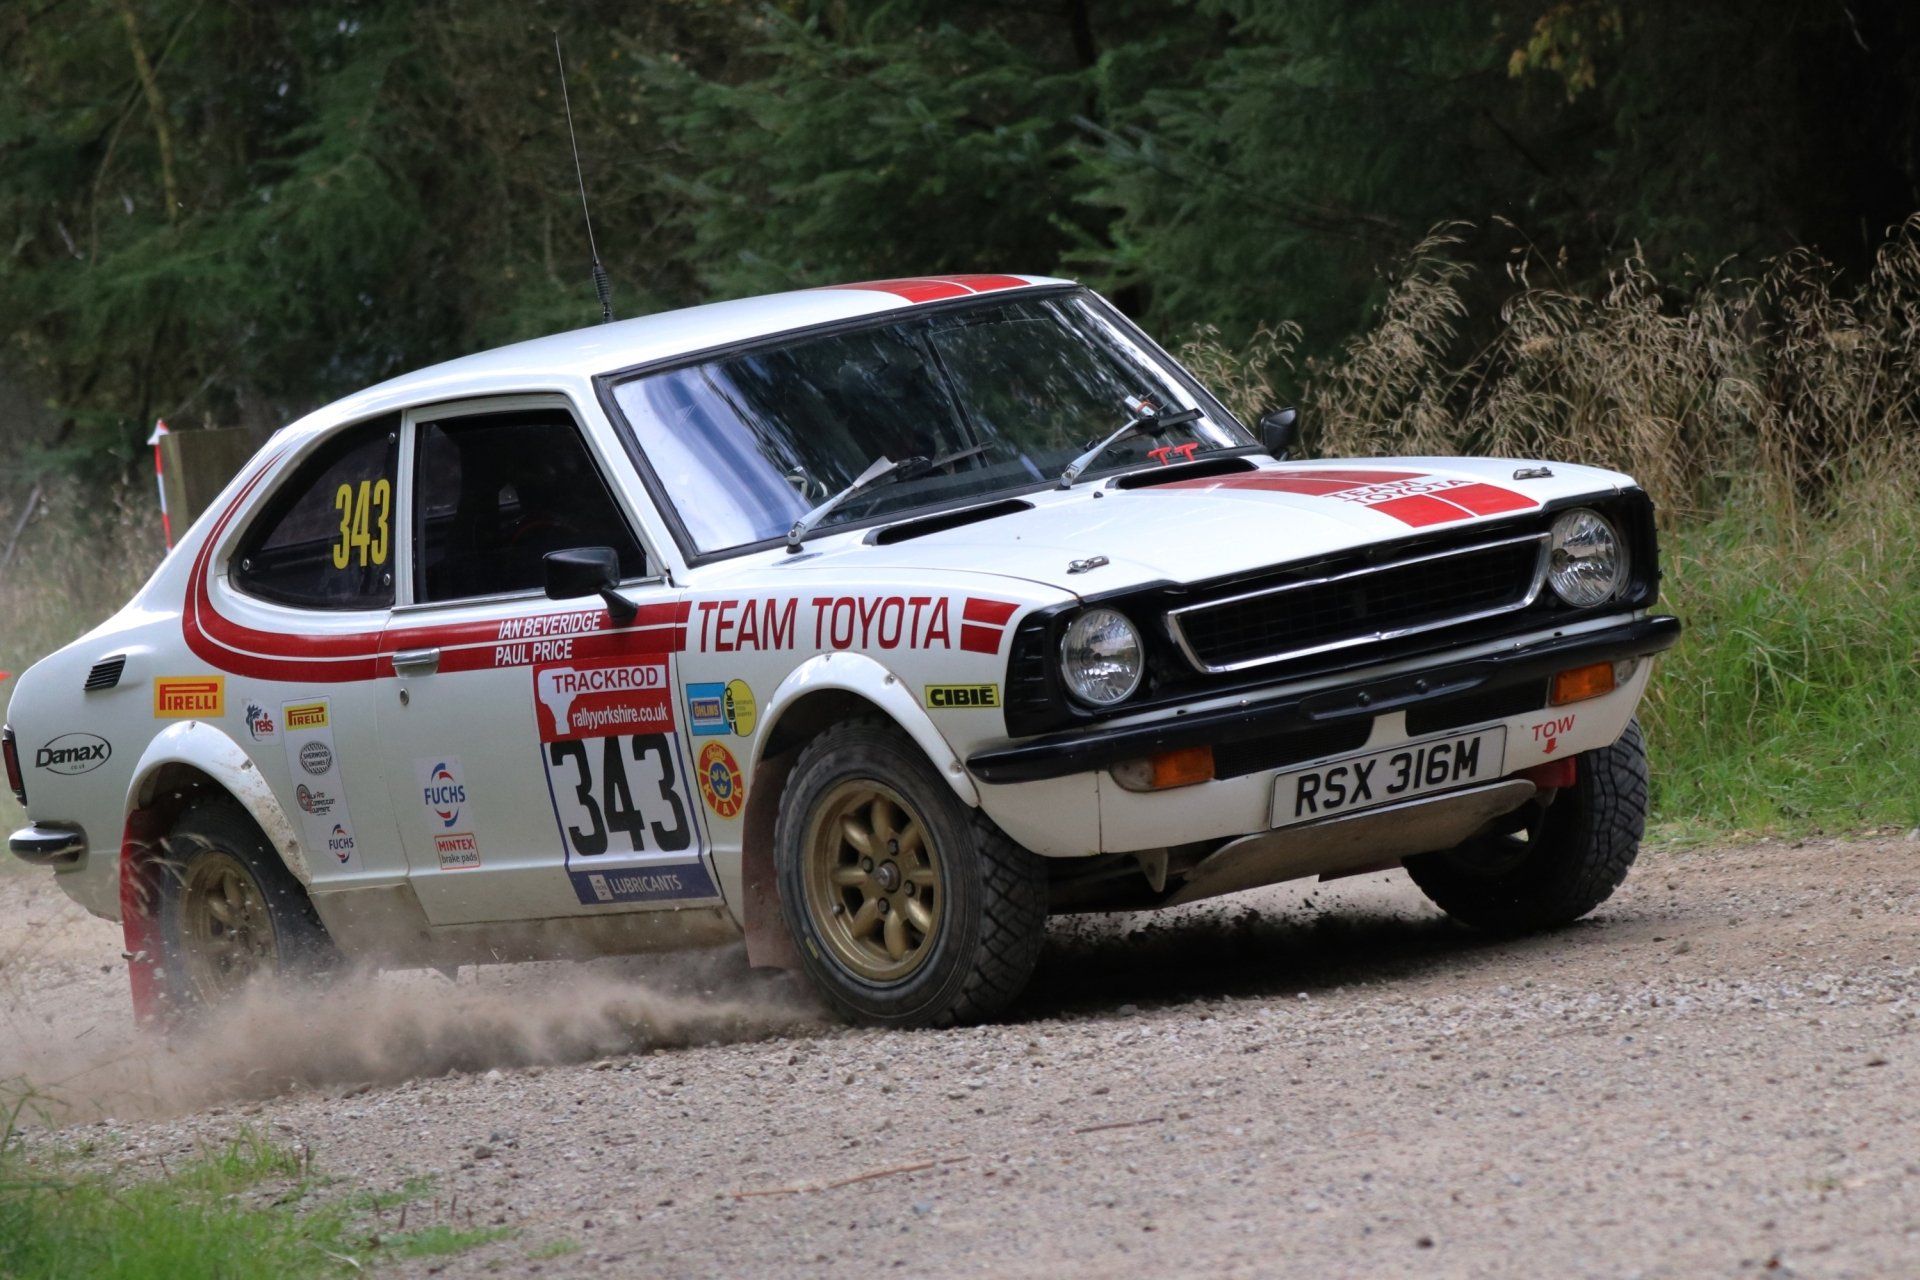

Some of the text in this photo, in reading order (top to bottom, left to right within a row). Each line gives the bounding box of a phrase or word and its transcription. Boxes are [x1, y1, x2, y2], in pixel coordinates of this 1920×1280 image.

[1322, 480, 1423, 501] TEAM
[1345, 479, 1475, 504] TOYOTA
[333, 479, 390, 570] 343
[498, 612, 603, 640] IAN BEVERIDGE
[699, 597, 951, 652] TEAM TOYOTA
[495, 640, 573, 666] PAUL PRICE
[552, 667, 658, 694] TRACKROD
[160, 683, 218, 711] PIRELLI
[254, 712, 274, 733] reis
[287, 706, 325, 726] PIRELLI
[572, 702, 668, 730] rallyyorkshire.co.uk
[1531, 715, 1576, 741] TOW
[35, 743, 105, 768] Damax
[1295, 737, 1481, 816] RSX 316M
[424, 785, 466, 805] FUCHS
[550, 732, 691, 857] 343
[328, 837, 354, 850] FUCHS
[437, 839, 475, 852] MINTEX
[441, 852, 478, 864] brake pads
[609, 874, 683, 894] LUBRICANTS
